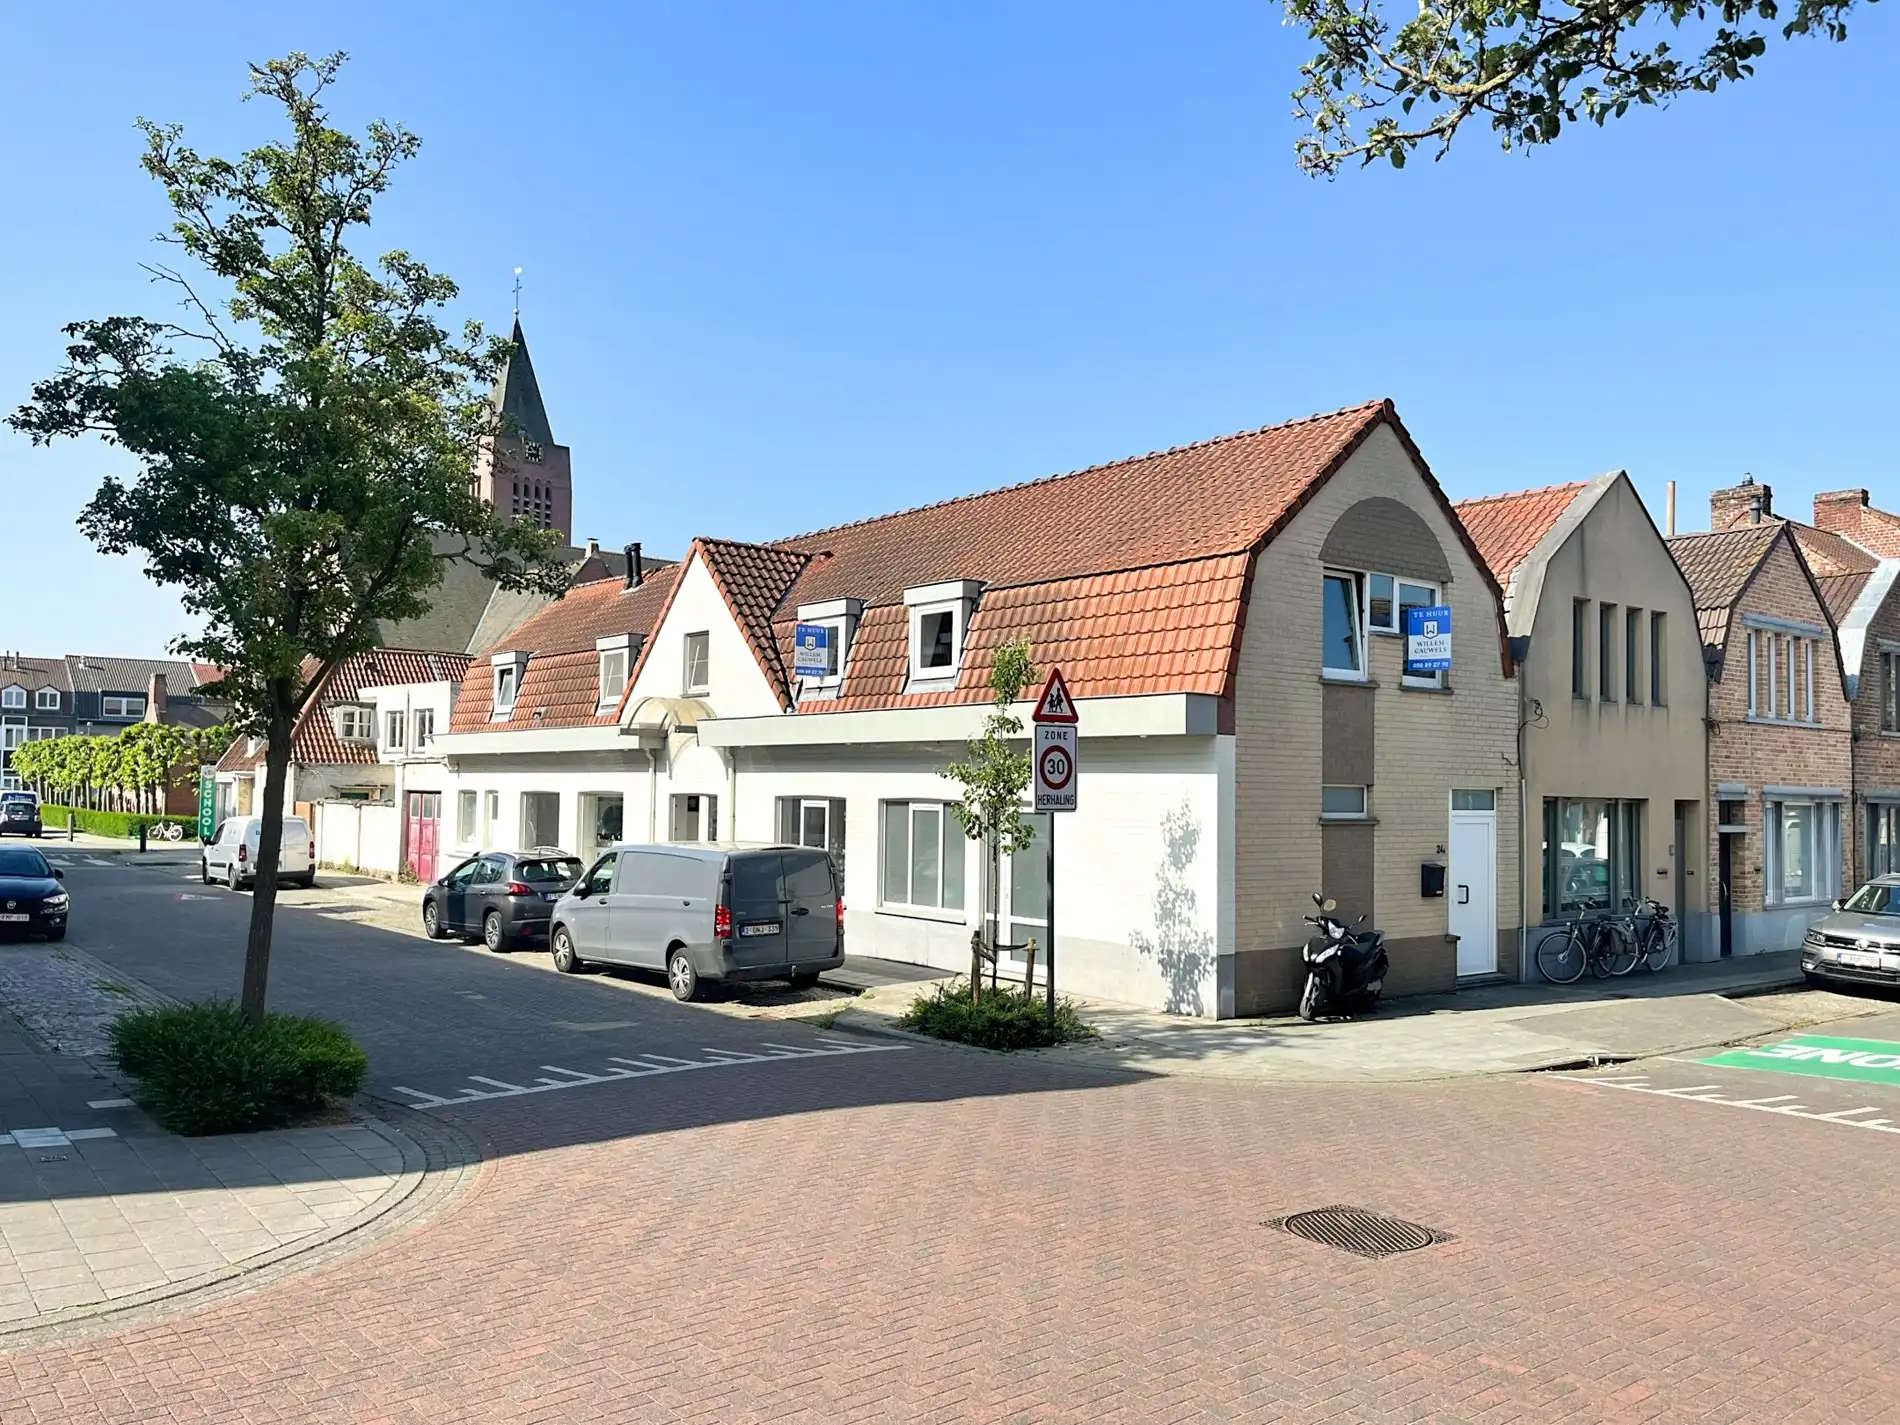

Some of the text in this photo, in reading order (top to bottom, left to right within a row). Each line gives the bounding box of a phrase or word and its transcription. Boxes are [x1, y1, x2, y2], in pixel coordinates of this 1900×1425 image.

[1044, 730, 1068, 740] ZONE
[1047, 758, 1065, 775] 30
[202, 780, 213, 836] SCHOOL
[1037, 794, 1075, 806] HERHALING
[1744, 1043, 1900, 1071] ONE
